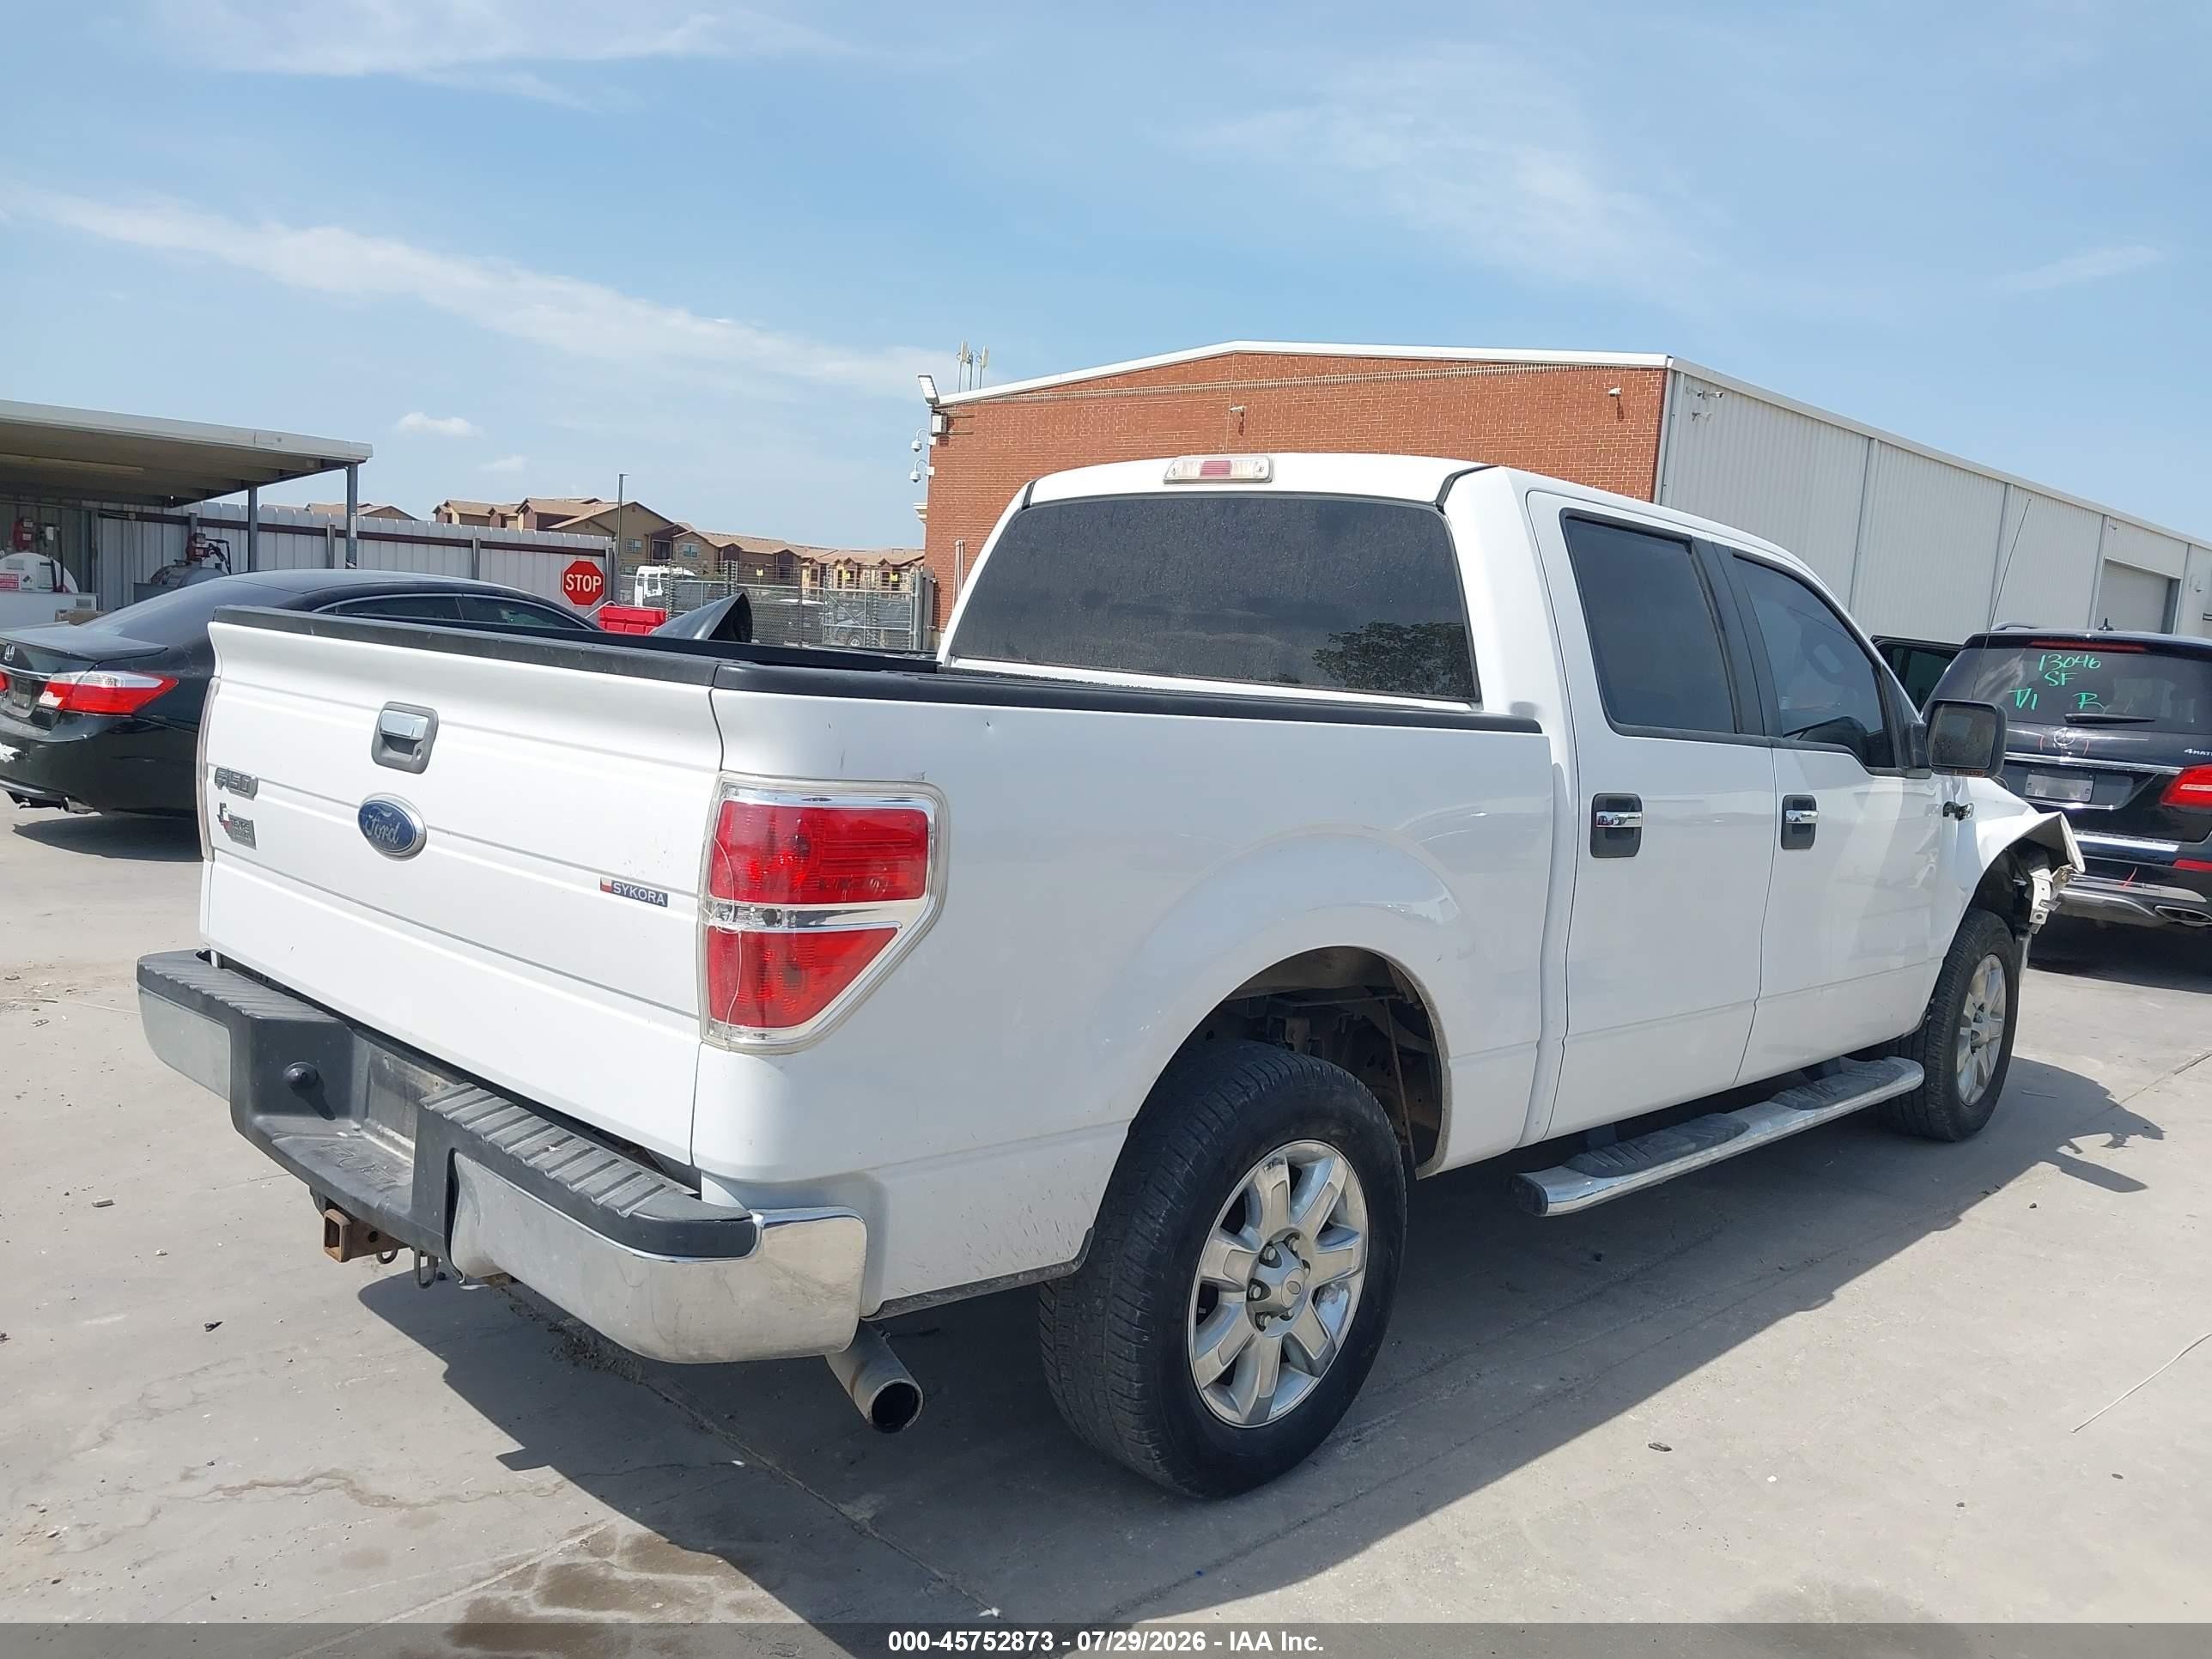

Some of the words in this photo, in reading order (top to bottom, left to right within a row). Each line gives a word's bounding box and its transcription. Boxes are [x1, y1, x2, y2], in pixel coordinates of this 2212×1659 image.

[565, 574, 602, 592] STOP
[2039, 653, 2101, 672] 13046
[2044, 671, 2078, 686] SF
[364, 805, 400, 845] Ford
[613, 882, 666, 906] SYKORA
